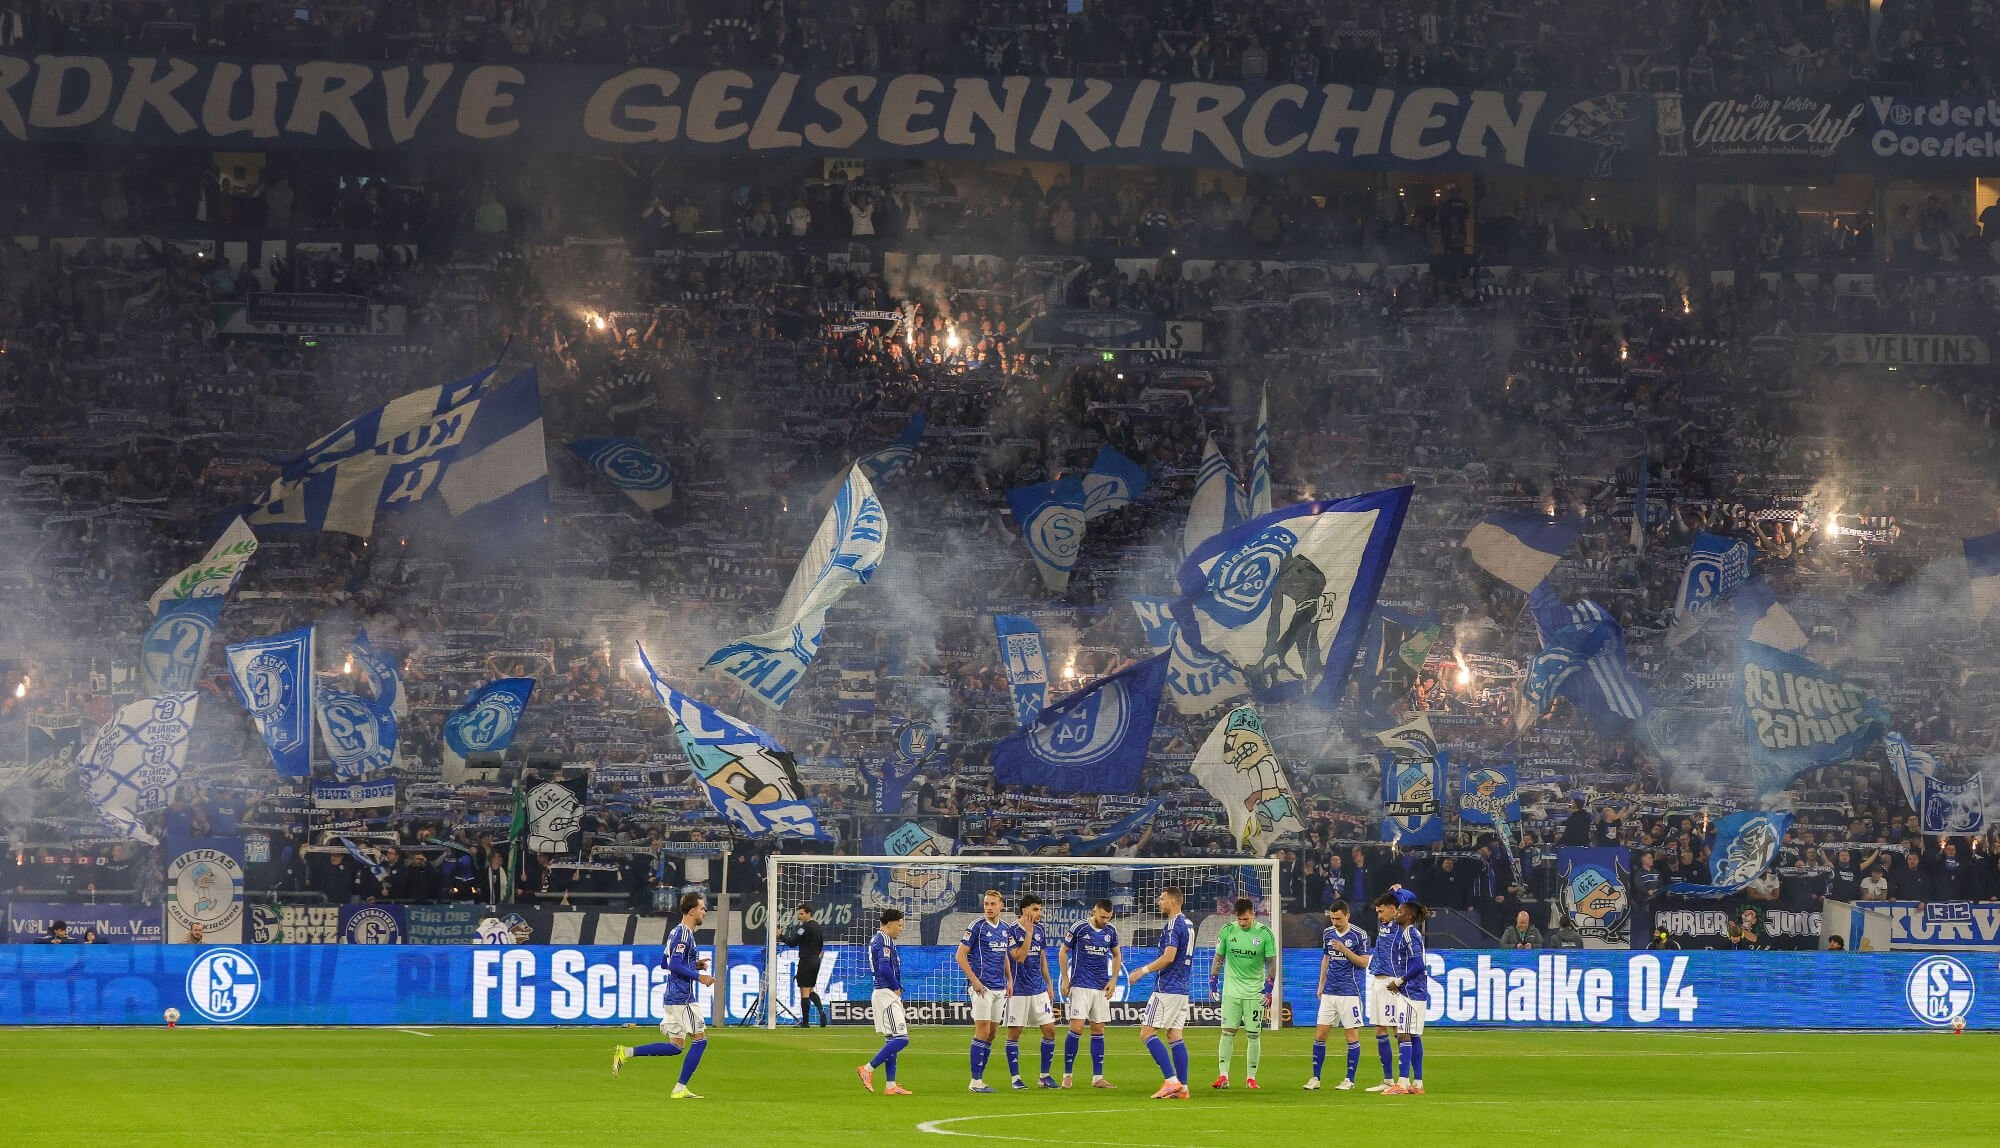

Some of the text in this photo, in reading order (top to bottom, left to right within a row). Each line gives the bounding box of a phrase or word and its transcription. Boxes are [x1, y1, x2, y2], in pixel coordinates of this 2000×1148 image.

[583, 67, 1546, 168] GELSENKIRCHEN
[1692, 98, 1864, 150] Glück Auf
[1863, 336, 1977, 364] VELTINS
[317, 785, 394, 800] BLUE BOYZ
[1460, 787, 1519, 814] Original
[176, 850, 236, 870] ULTRAS
[171, 904, 240, 930] GELSEKIRCHEN
[282, 906, 340, 926] BLUE
[410, 906, 439, 922] FÜR
[835, 904, 852, 924] 75
[1927, 903, 1970, 920] 1312
[97, 919, 129, 935] NULL
[129, 919, 161, 935] VIER
[409, 924, 463, 935] JUNGS
[1655, 910, 1729, 938] MARLER
[282, 926, 338, 944] BOYZ
[1230, 948, 1257, 956] SUN
[472, 949, 536, 1020] FC
[550, 948, 760, 1020] Schae
[1628, 955, 1698, 1023] 04
[831, 1001, 946, 1021] Eiseach
[1352, 1006, 1359, 1018] 6
[1385, 1004, 1395, 1017] 21
